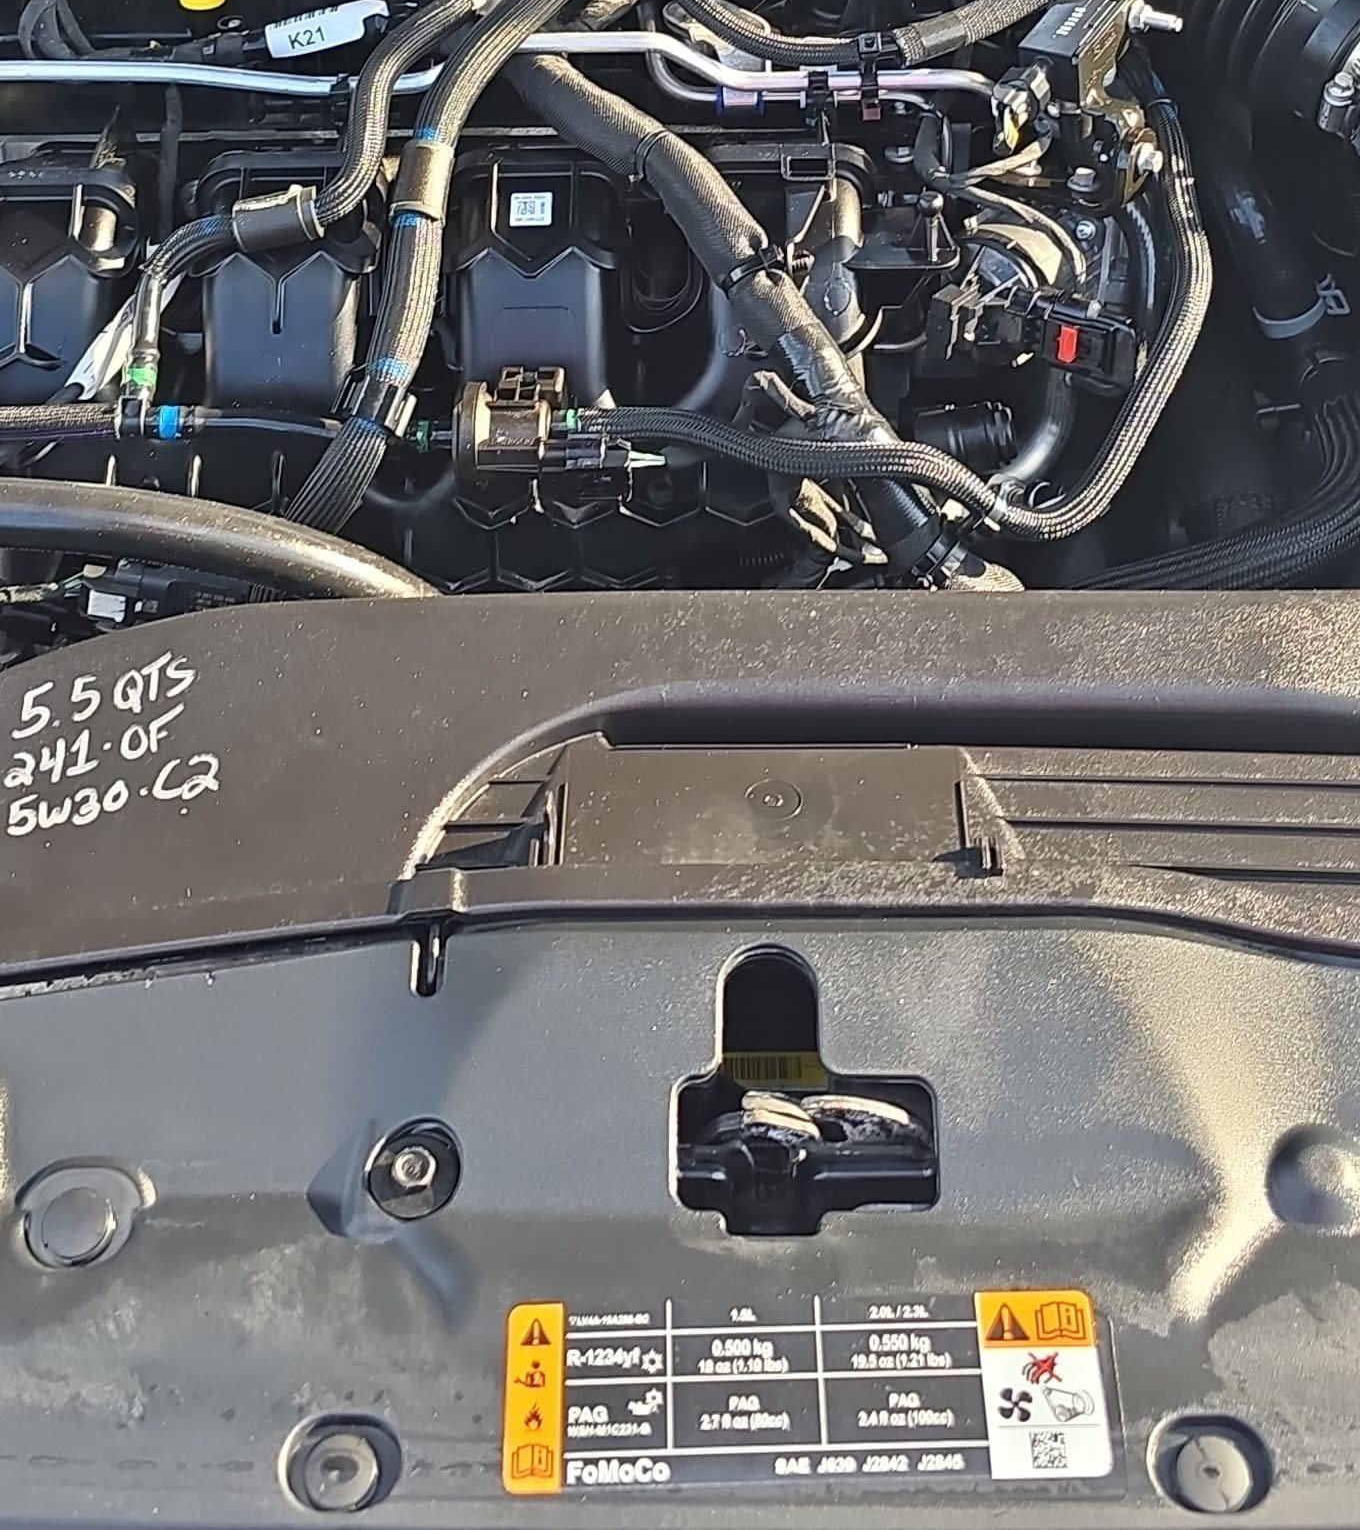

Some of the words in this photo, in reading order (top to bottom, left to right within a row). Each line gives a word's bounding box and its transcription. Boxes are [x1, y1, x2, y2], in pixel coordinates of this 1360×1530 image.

[288, 26, 326, 50] K21
[113, 651, 196, 713] QTS
[711, 1338, 752, 1357] 0.500
[753, 1337, 774, 1359] kg
[869, 1334, 909, 1351] 0.550
[910, 1333, 932, 1354] kg
[566, 1347, 641, 1368] R-1234yf
[878, 1355, 894, 1368] oz
[715, 1361, 731, 1374] oz
[728, 1395, 761, 1411] PAG
[888, 1392, 921, 1408] PAG
[567, 1405, 609, 1424] PAG
[732, 1416, 749, 1430] oz
[890, 1412, 907, 1426] oz
[566, 1457, 671, 1485] FoMoCo
[774, 1456, 812, 1475] SAE
